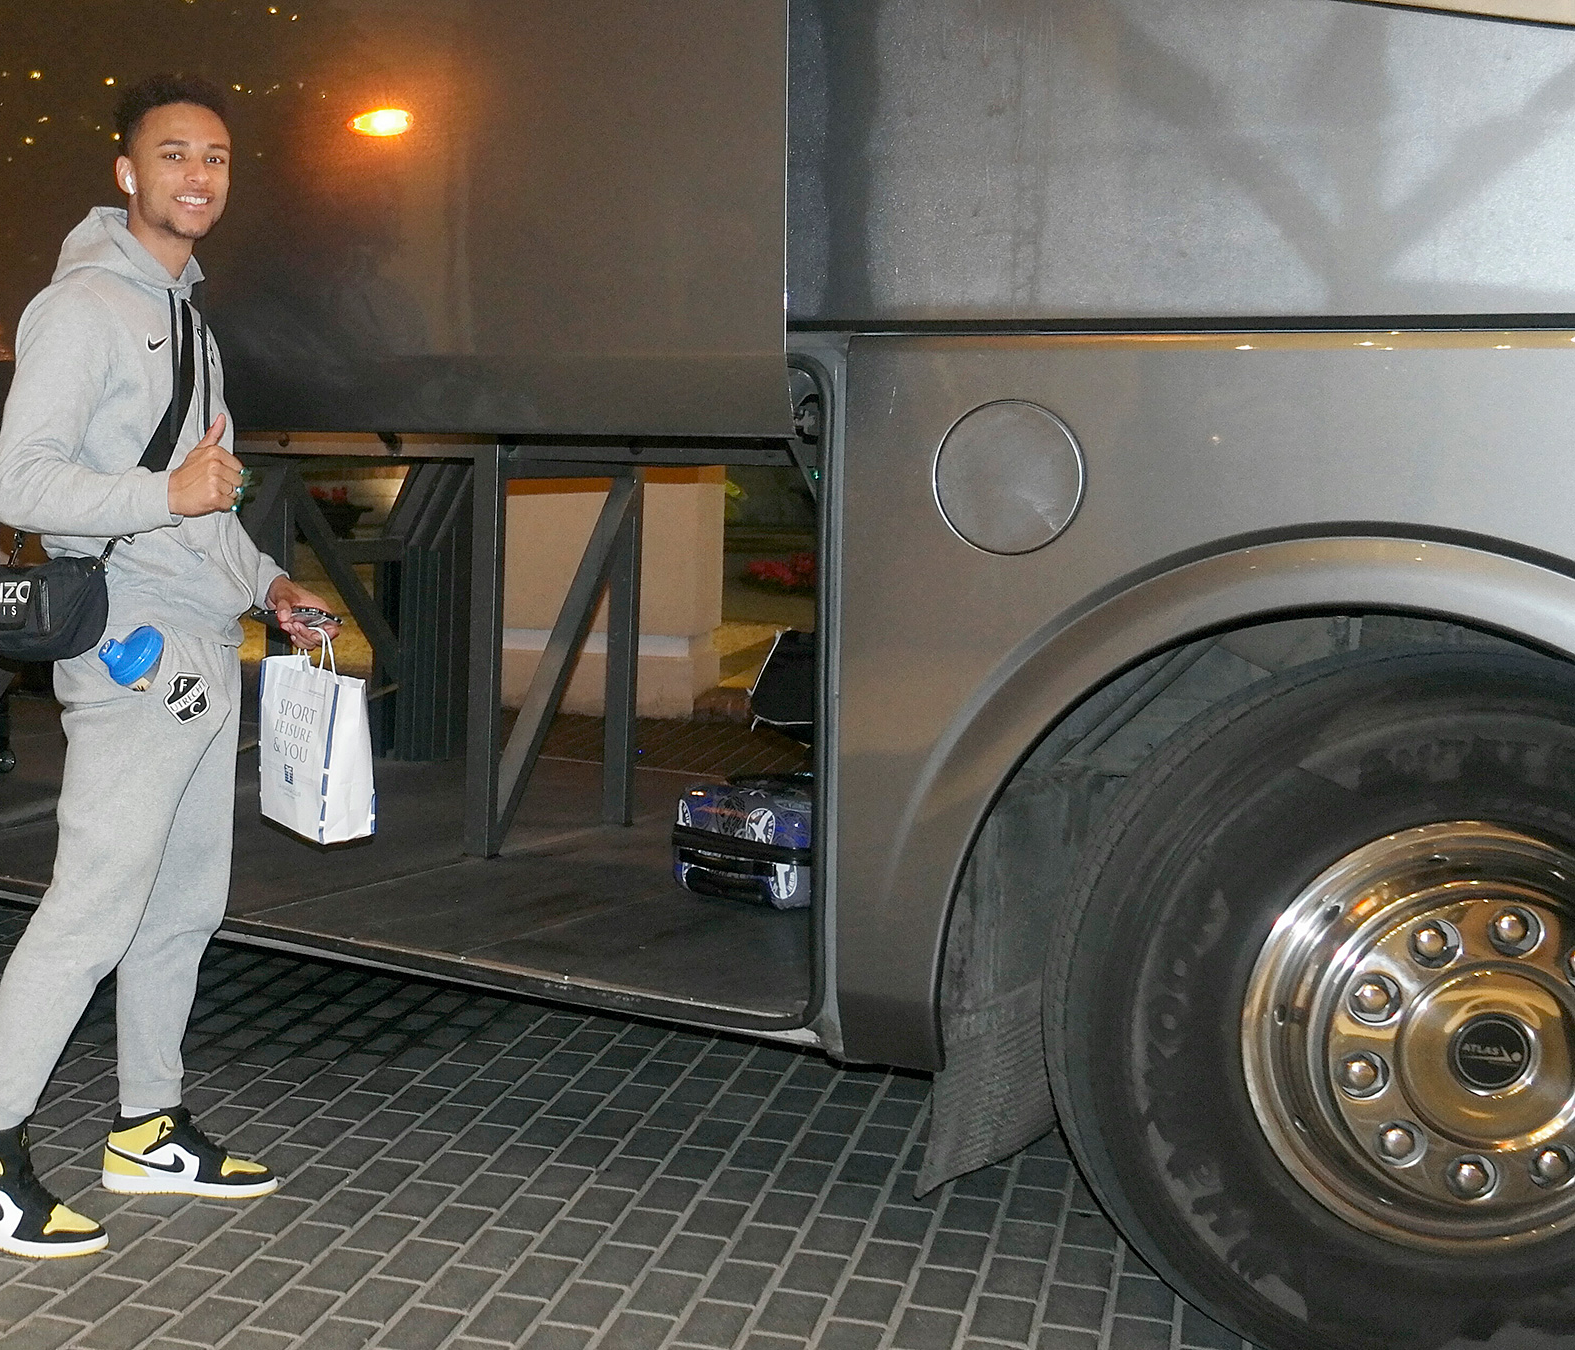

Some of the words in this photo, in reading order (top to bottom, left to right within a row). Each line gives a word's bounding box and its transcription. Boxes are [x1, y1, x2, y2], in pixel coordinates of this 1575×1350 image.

[169, 677, 207, 712] UTRECHT
[278, 698, 318, 725] SPORT
[274, 719, 313, 743] LEISURE
[273, 736, 281, 753] &
[283, 740, 309, 763] YOU
